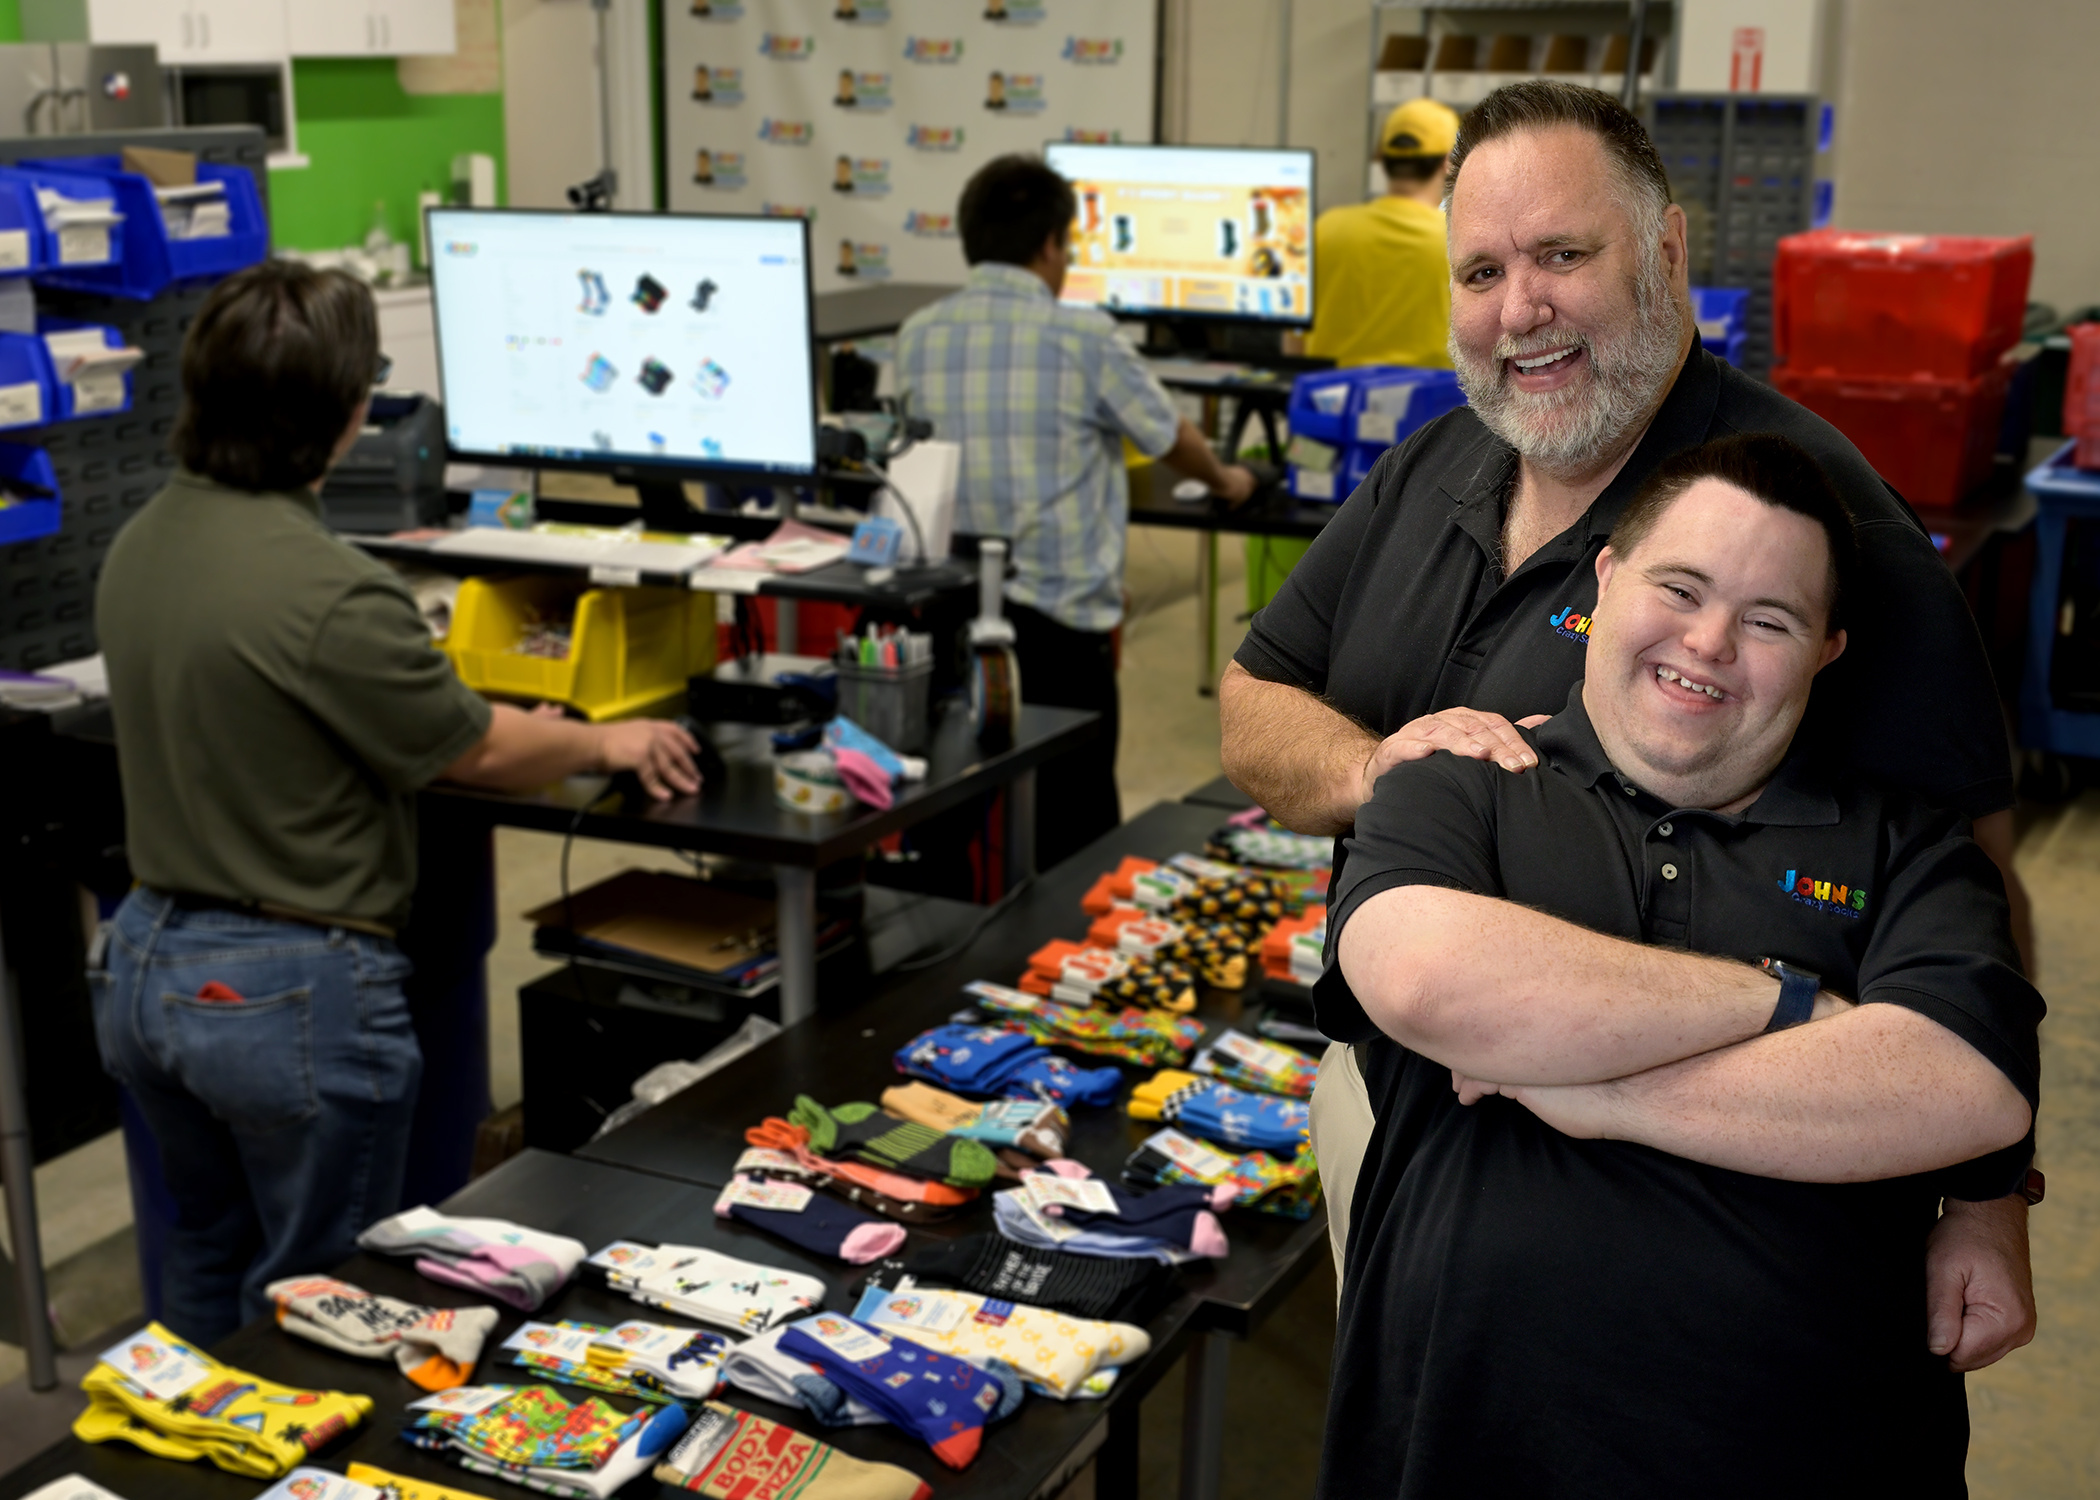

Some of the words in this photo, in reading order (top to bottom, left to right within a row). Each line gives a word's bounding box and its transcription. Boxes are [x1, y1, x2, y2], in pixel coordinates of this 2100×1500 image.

[1556, 626, 1580, 642] Crazy
[1777, 870, 1867, 910] JOHN'S
[1791, 892, 1824, 911] Crazy
[1828, 902, 1861, 919] Socks
[713, 1419, 768, 1490] BODY
[749, 1444, 781, 1481] BY
[753, 1443, 812, 1500] PIZZA
